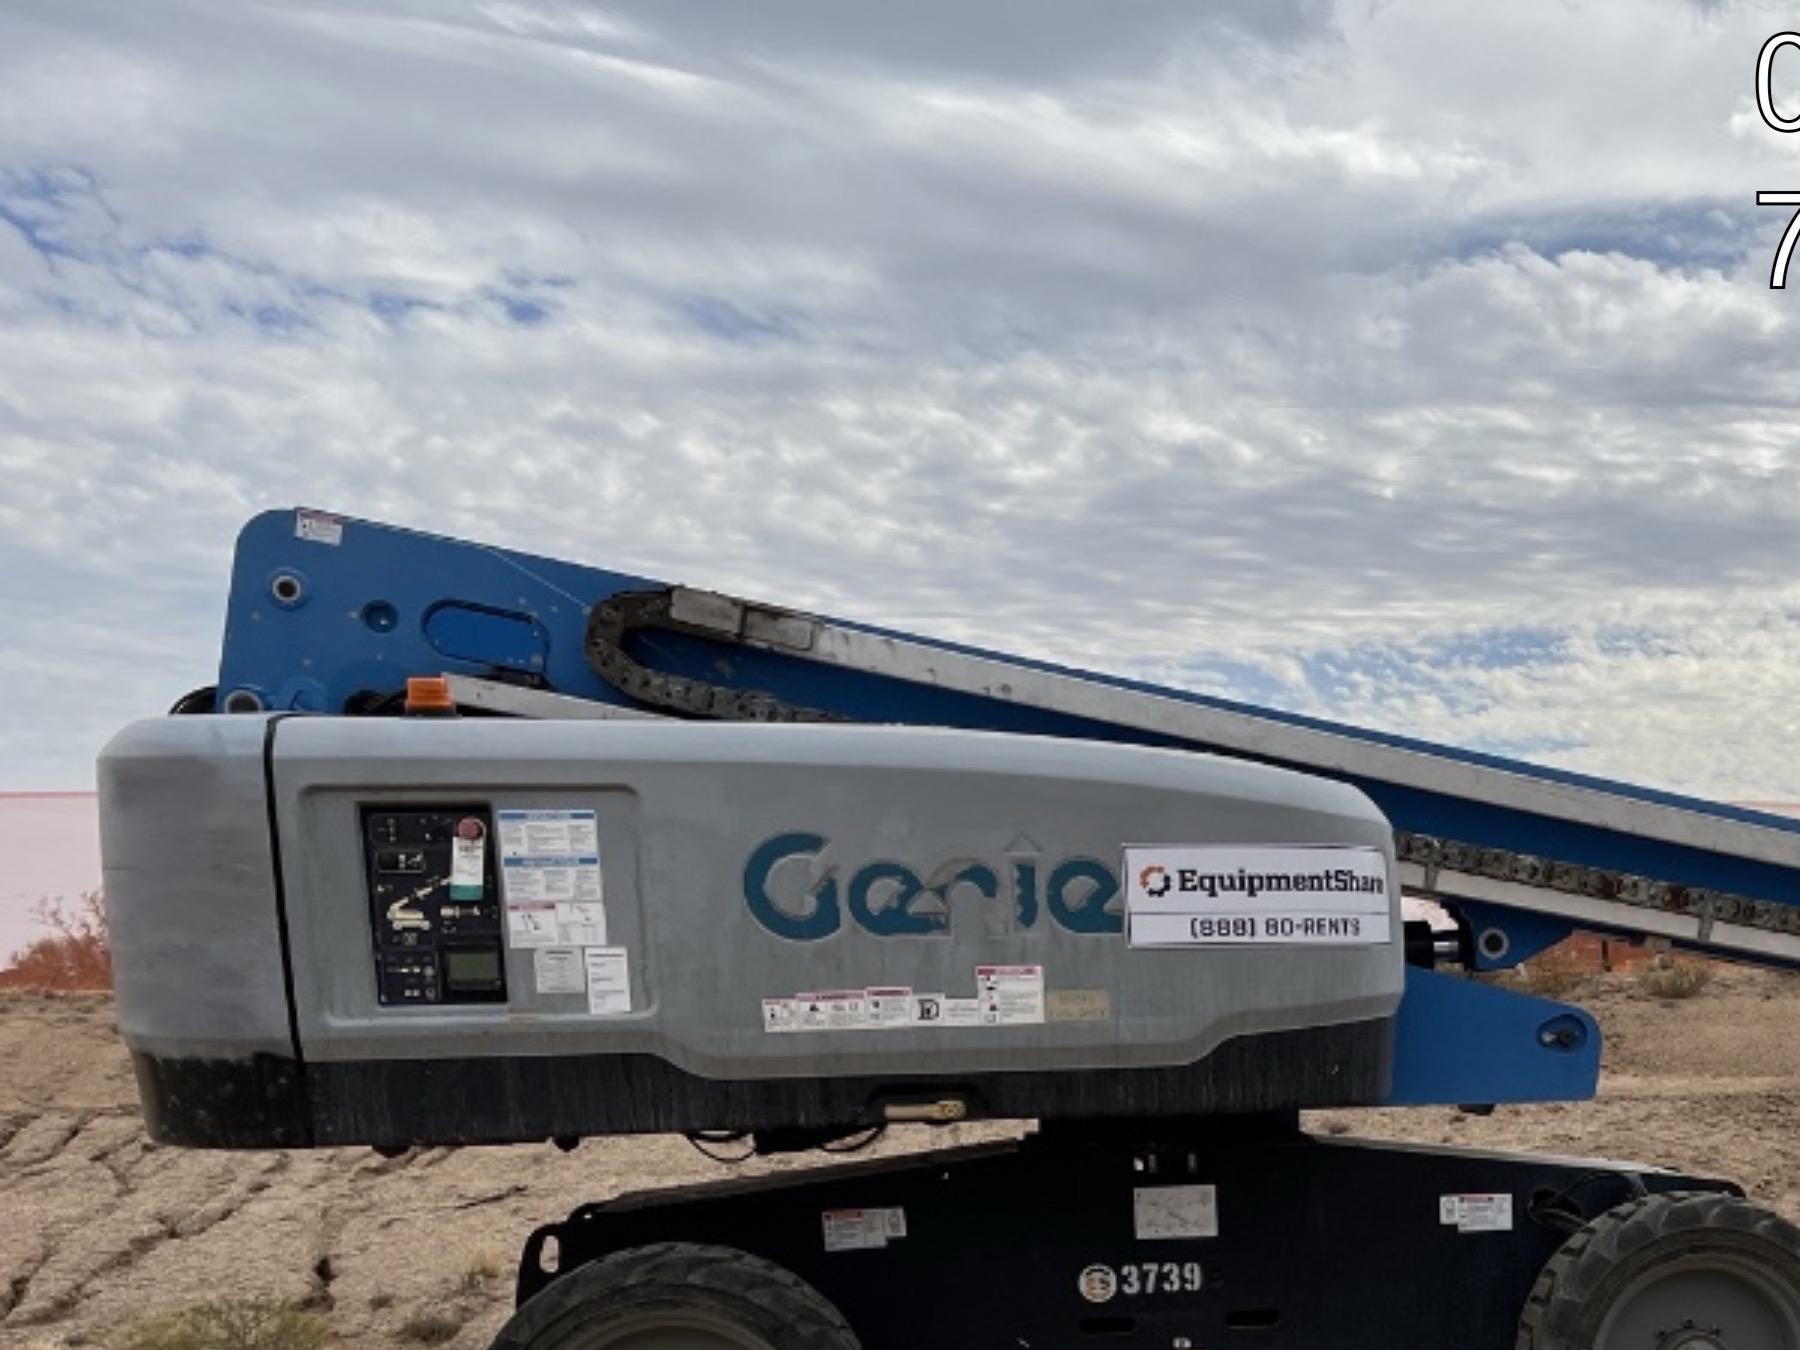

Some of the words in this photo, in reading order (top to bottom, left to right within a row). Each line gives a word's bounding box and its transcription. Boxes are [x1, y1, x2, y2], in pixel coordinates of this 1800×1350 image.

[743, 831, 1127, 942] Genie
[1190, 917, 1256, 939] (888)
[1120, 1262, 1202, 1295] 3739
